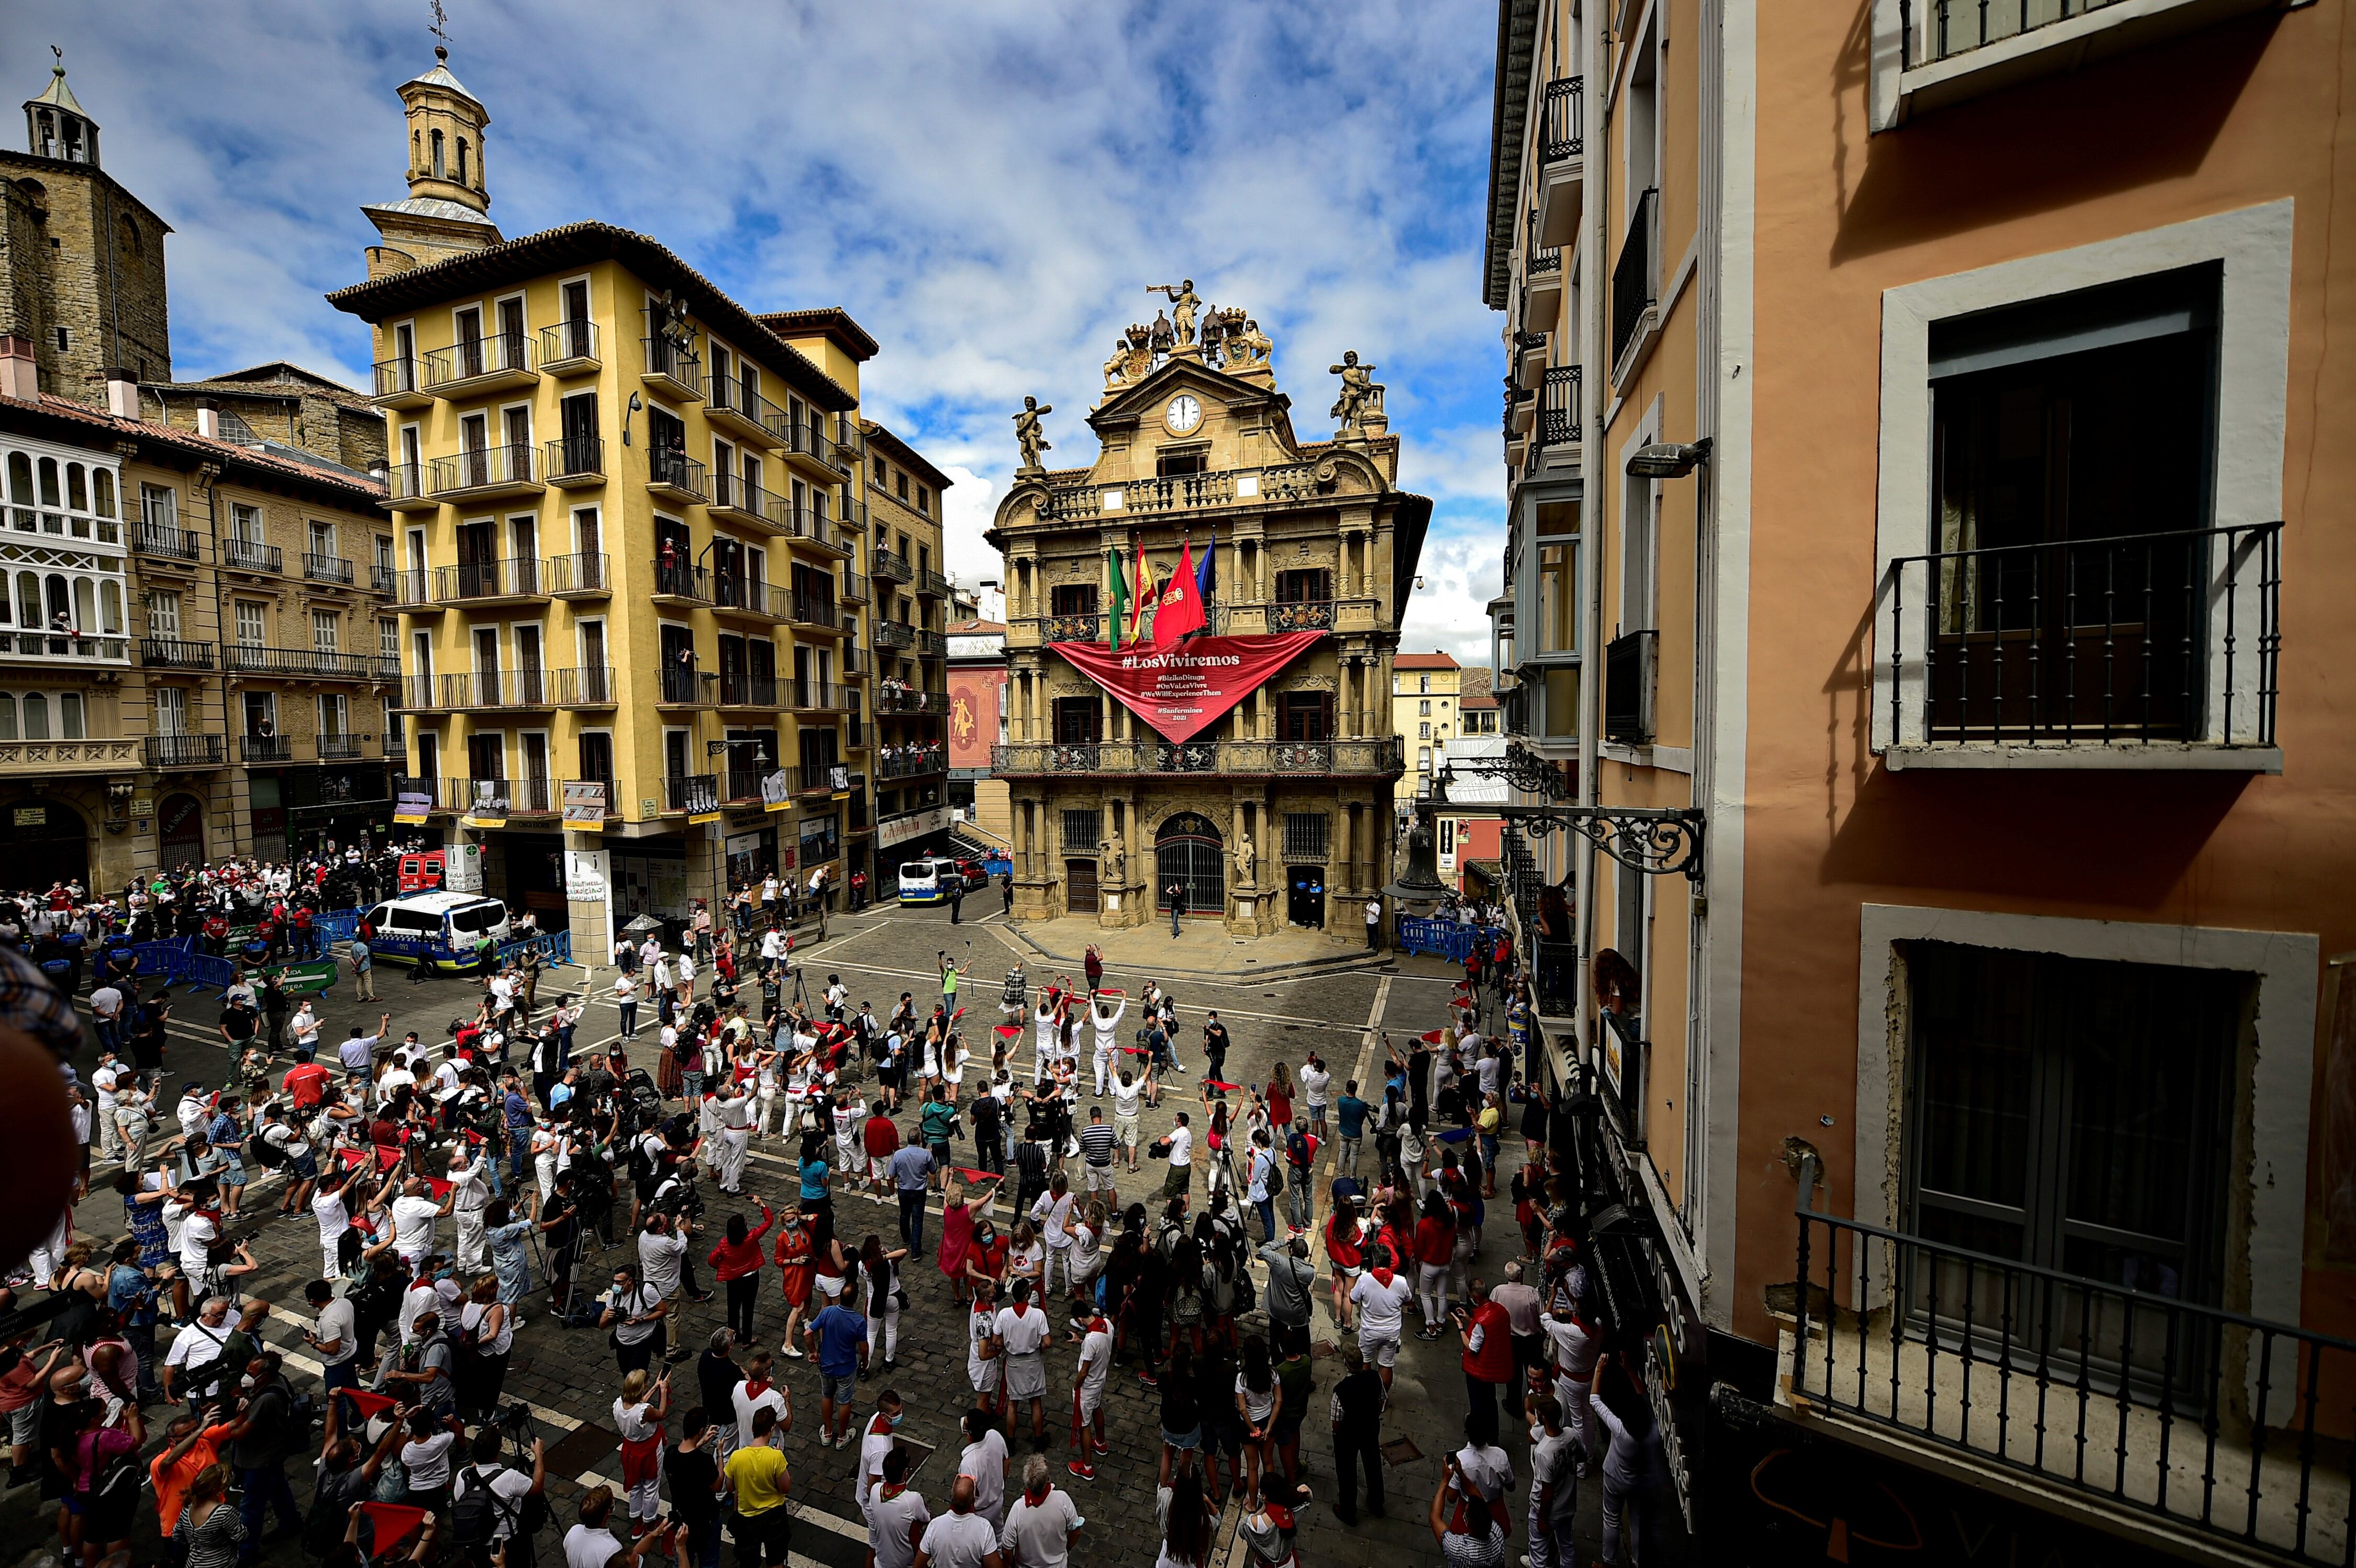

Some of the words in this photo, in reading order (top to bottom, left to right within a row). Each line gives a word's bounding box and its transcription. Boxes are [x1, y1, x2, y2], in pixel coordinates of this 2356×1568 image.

[1122, 653, 1240, 669] #LosViviremos
[1141, 690, 1221, 698] #WeWillExperienceThem
[253, 826, 283, 834] CALZADOS
[162, 833, 199, 843] CALZADOS
